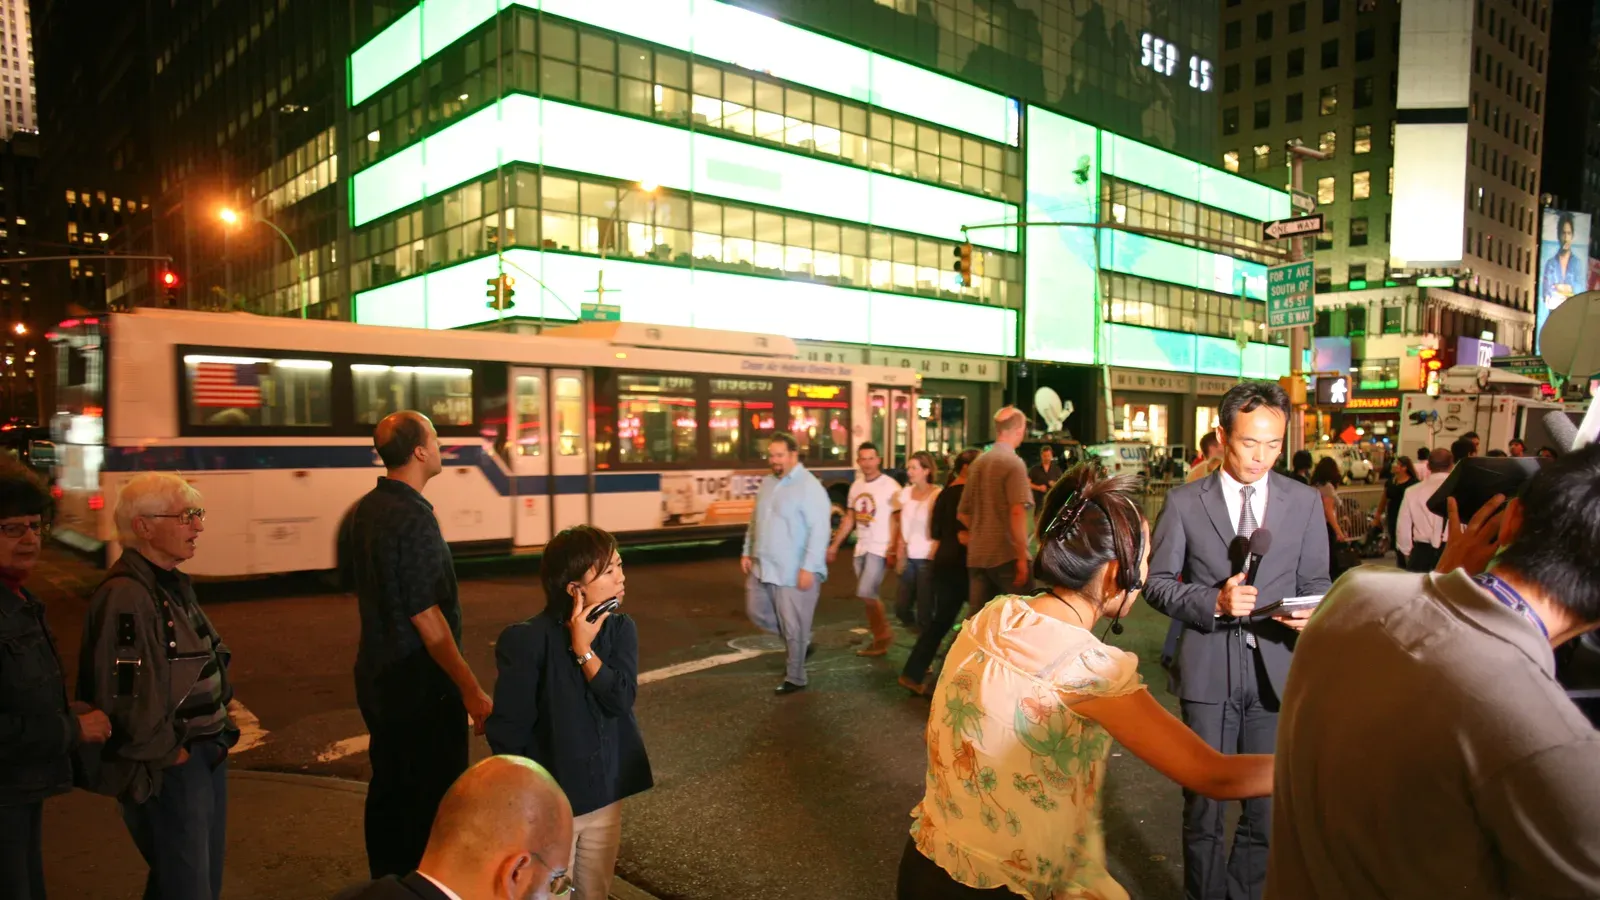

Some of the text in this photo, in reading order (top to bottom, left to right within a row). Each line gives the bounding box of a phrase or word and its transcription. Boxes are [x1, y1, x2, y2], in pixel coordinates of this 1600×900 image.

[1141, 32, 1214, 92] SEP 15
[1271, 220, 1316, 235] ONE WAY
[1270, 265, 1311, 282] FOR 7 AVE
[1271, 283, 1296, 296] SOUTH
[1299, 280, 1309, 291] OF
[1283, 296, 1294, 308] 45
[1296, 295, 1307, 307] ST
[1271, 312, 1285, 325] USE
[883, 356, 988, 375] LONDON
